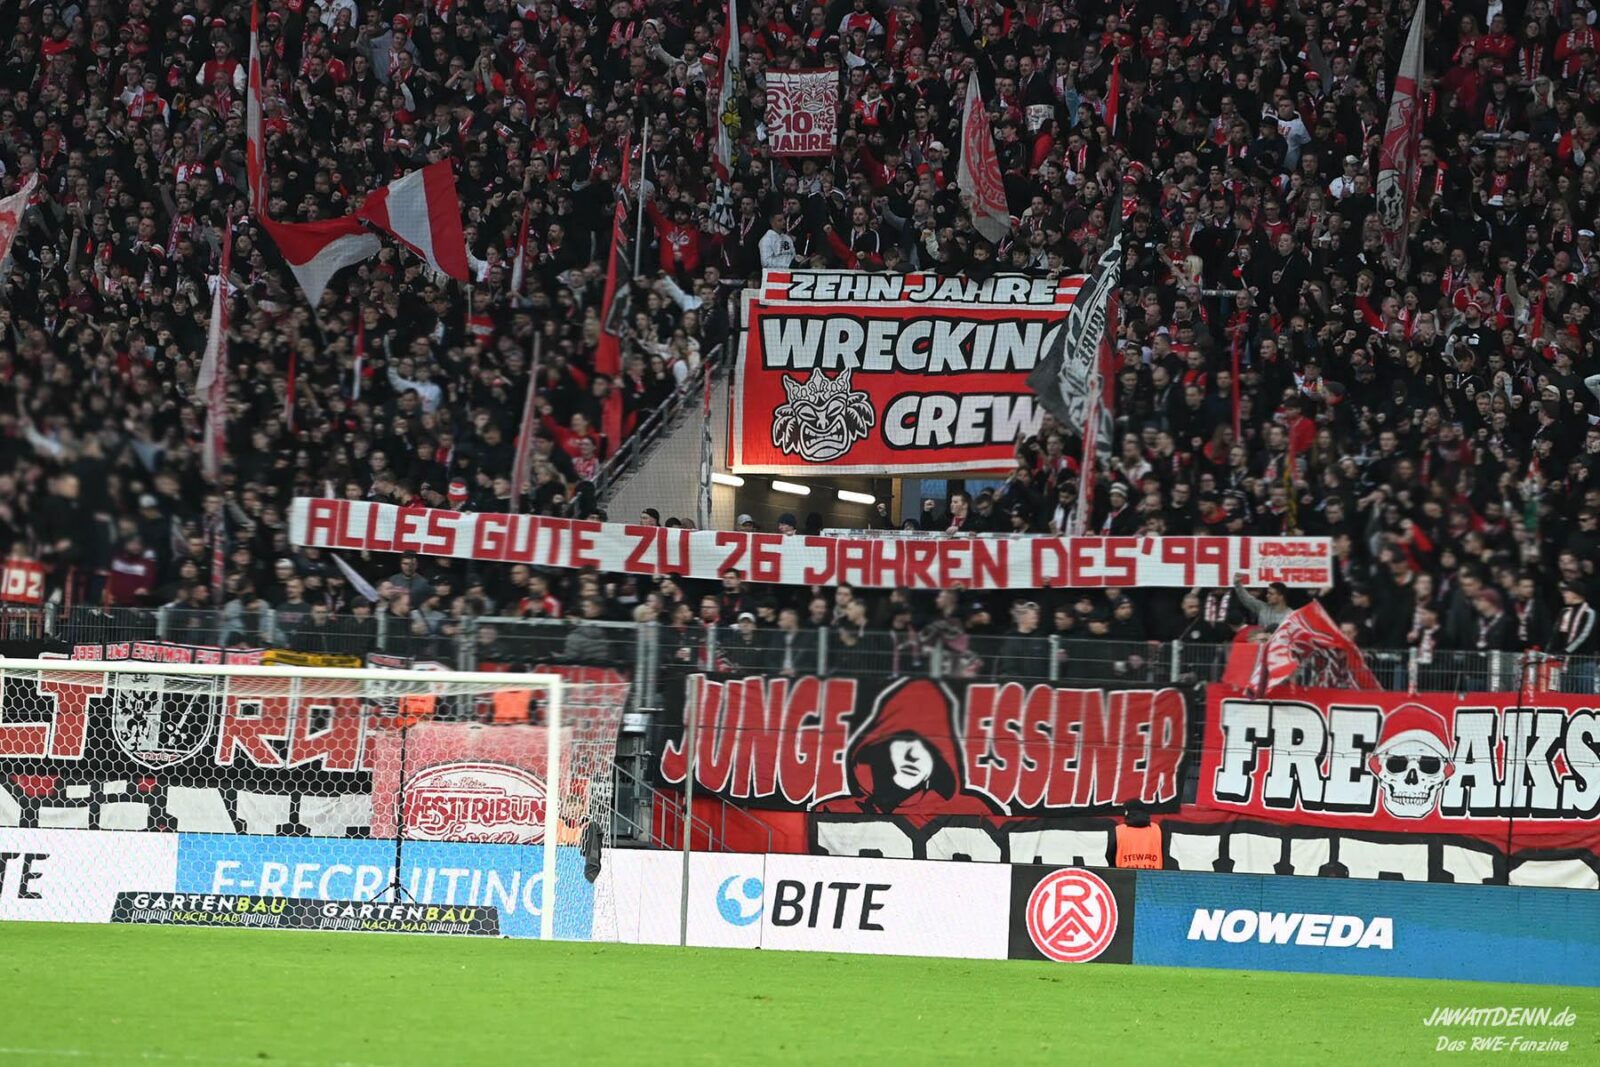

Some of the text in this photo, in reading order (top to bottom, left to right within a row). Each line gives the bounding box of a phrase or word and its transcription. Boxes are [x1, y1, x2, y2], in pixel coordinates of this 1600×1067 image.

[782, 111, 813, 133] 10
[772, 133, 832, 152] JAHRE
[788, 273, 1057, 303] ZEHN JAHRE
[306, 498, 457, 554] ALLES
[472, 513, 602, 568] GUTE
[624, 525, 692, 575] ZU
[717, 532, 784, 582] 26
[803, 536, 1007, 588] JAHREN
[660, 673, 857, 805] JUNGE
[963, 682, 1188, 809] ESSENER
[1123, 854, 1158, 862] STEWARD
[134, 893, 287, 913] GARTENBAU
[323, 902, 476, 922] GARTENBAU
[771, 879, 892, 931] BITE
[173, 911, 207, 922] NACH
[361, 920, 396, 930] NACH
[1187, 908, 1394, 949] NOWEDA
